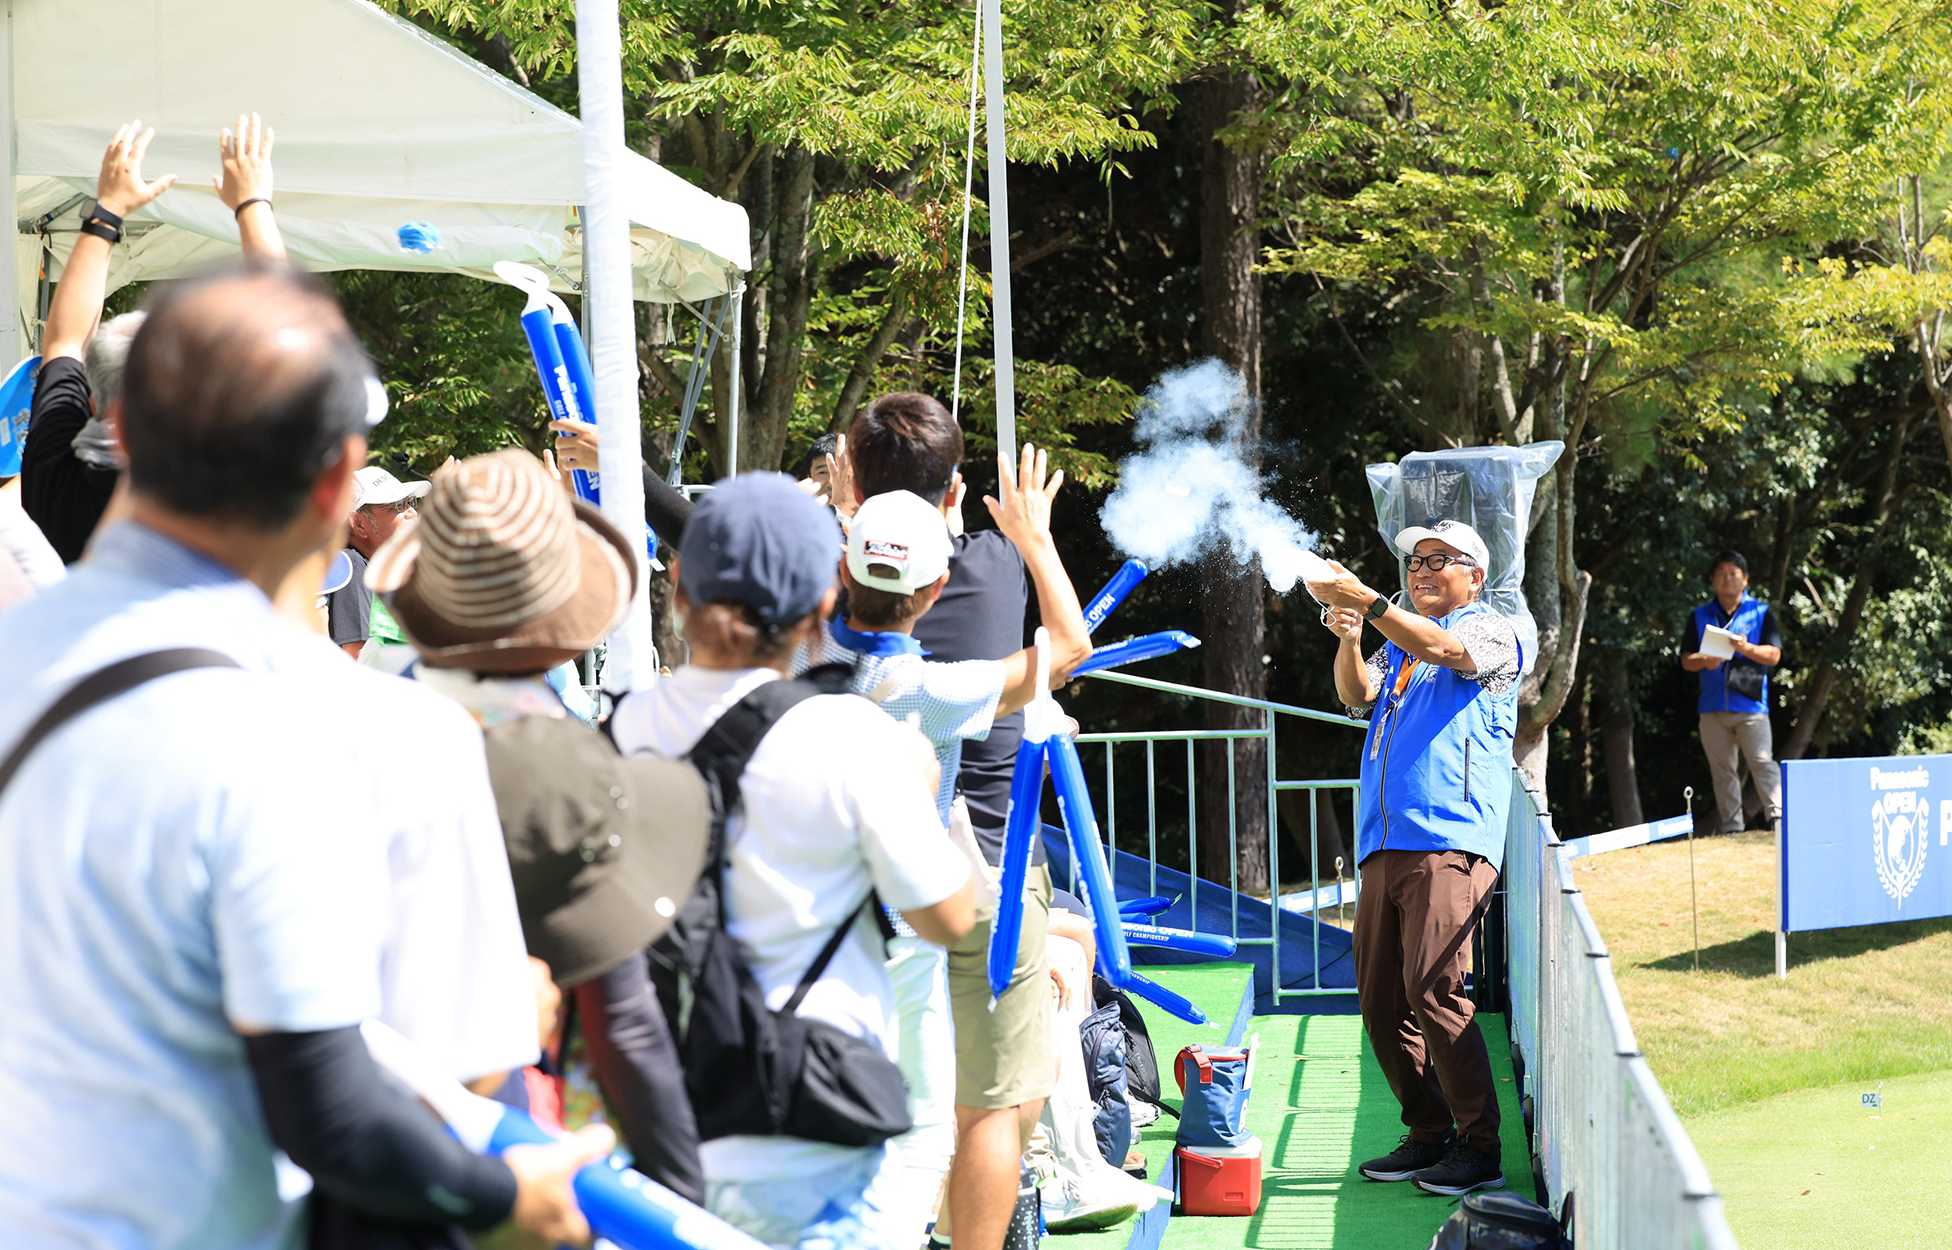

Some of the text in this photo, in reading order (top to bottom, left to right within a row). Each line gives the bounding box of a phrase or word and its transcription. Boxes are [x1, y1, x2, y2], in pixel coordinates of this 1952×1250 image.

[1088, 593, 1116, 618] OPEN
[1883, 791, 1917, 815] OPEN
[1132, 932, 1170, 942] CHAMPIONSHIP
[1158, 926, 1194, 938] OPEN
[1862, 1093, 1876, 1104] DZ
